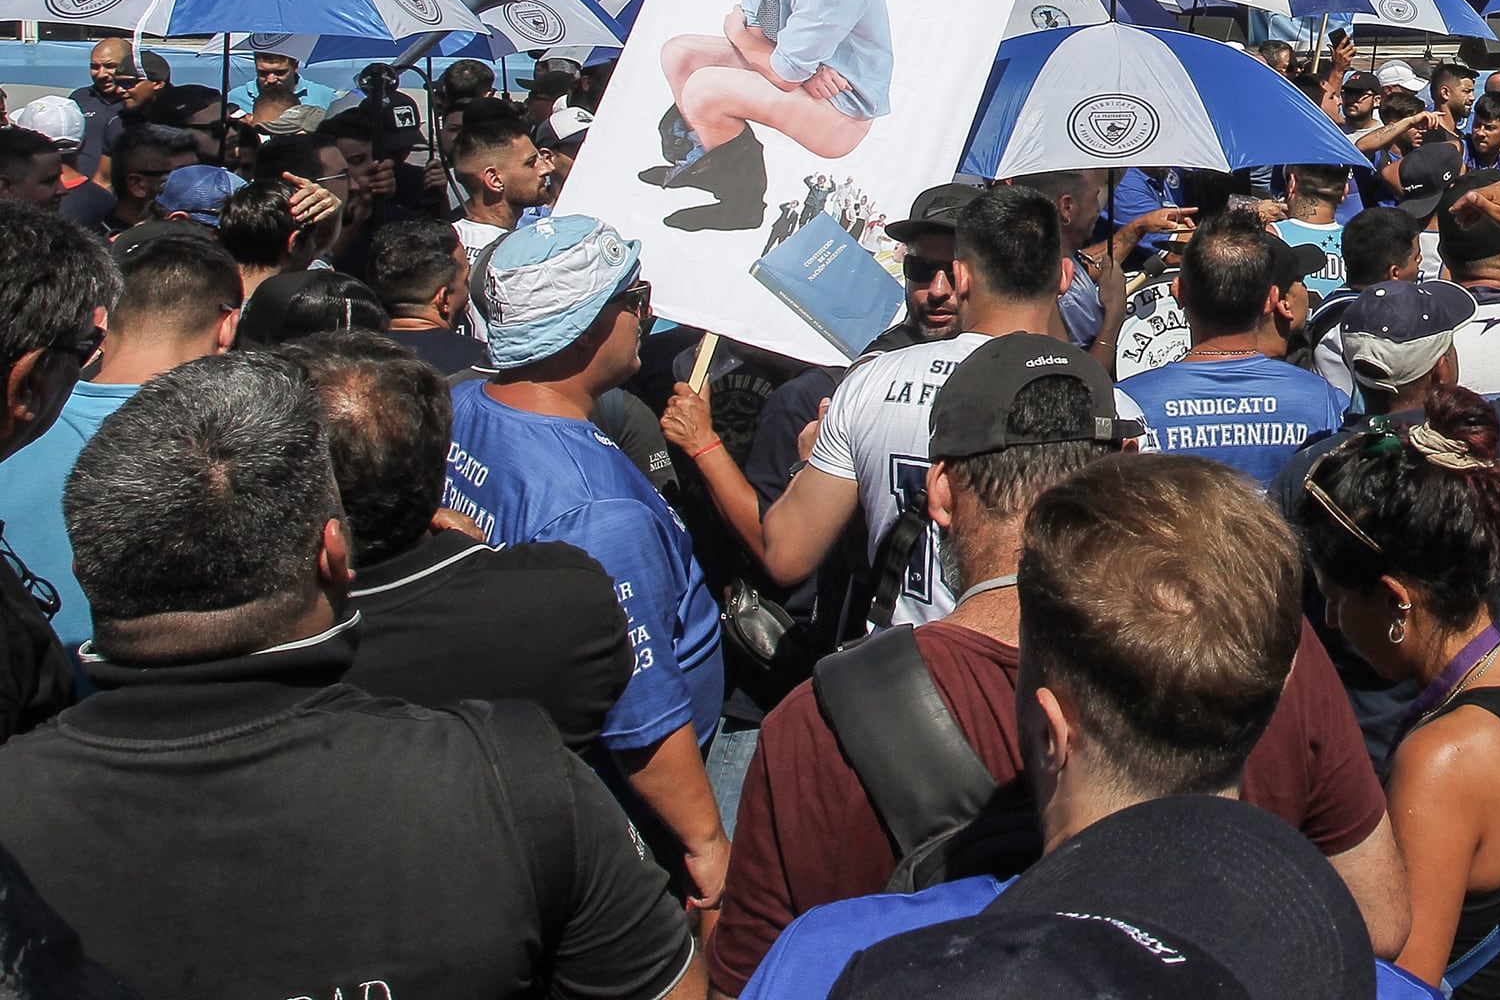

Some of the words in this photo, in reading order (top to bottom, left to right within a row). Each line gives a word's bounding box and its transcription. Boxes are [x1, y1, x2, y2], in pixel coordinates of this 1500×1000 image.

[1025, 355, 1069, 368] adidas
[884, 380, 913, 405] LA
[1164, 396, 1278, 418] SINDICATO
[1166, 422, 1309, 451] FRATERNIDAD
